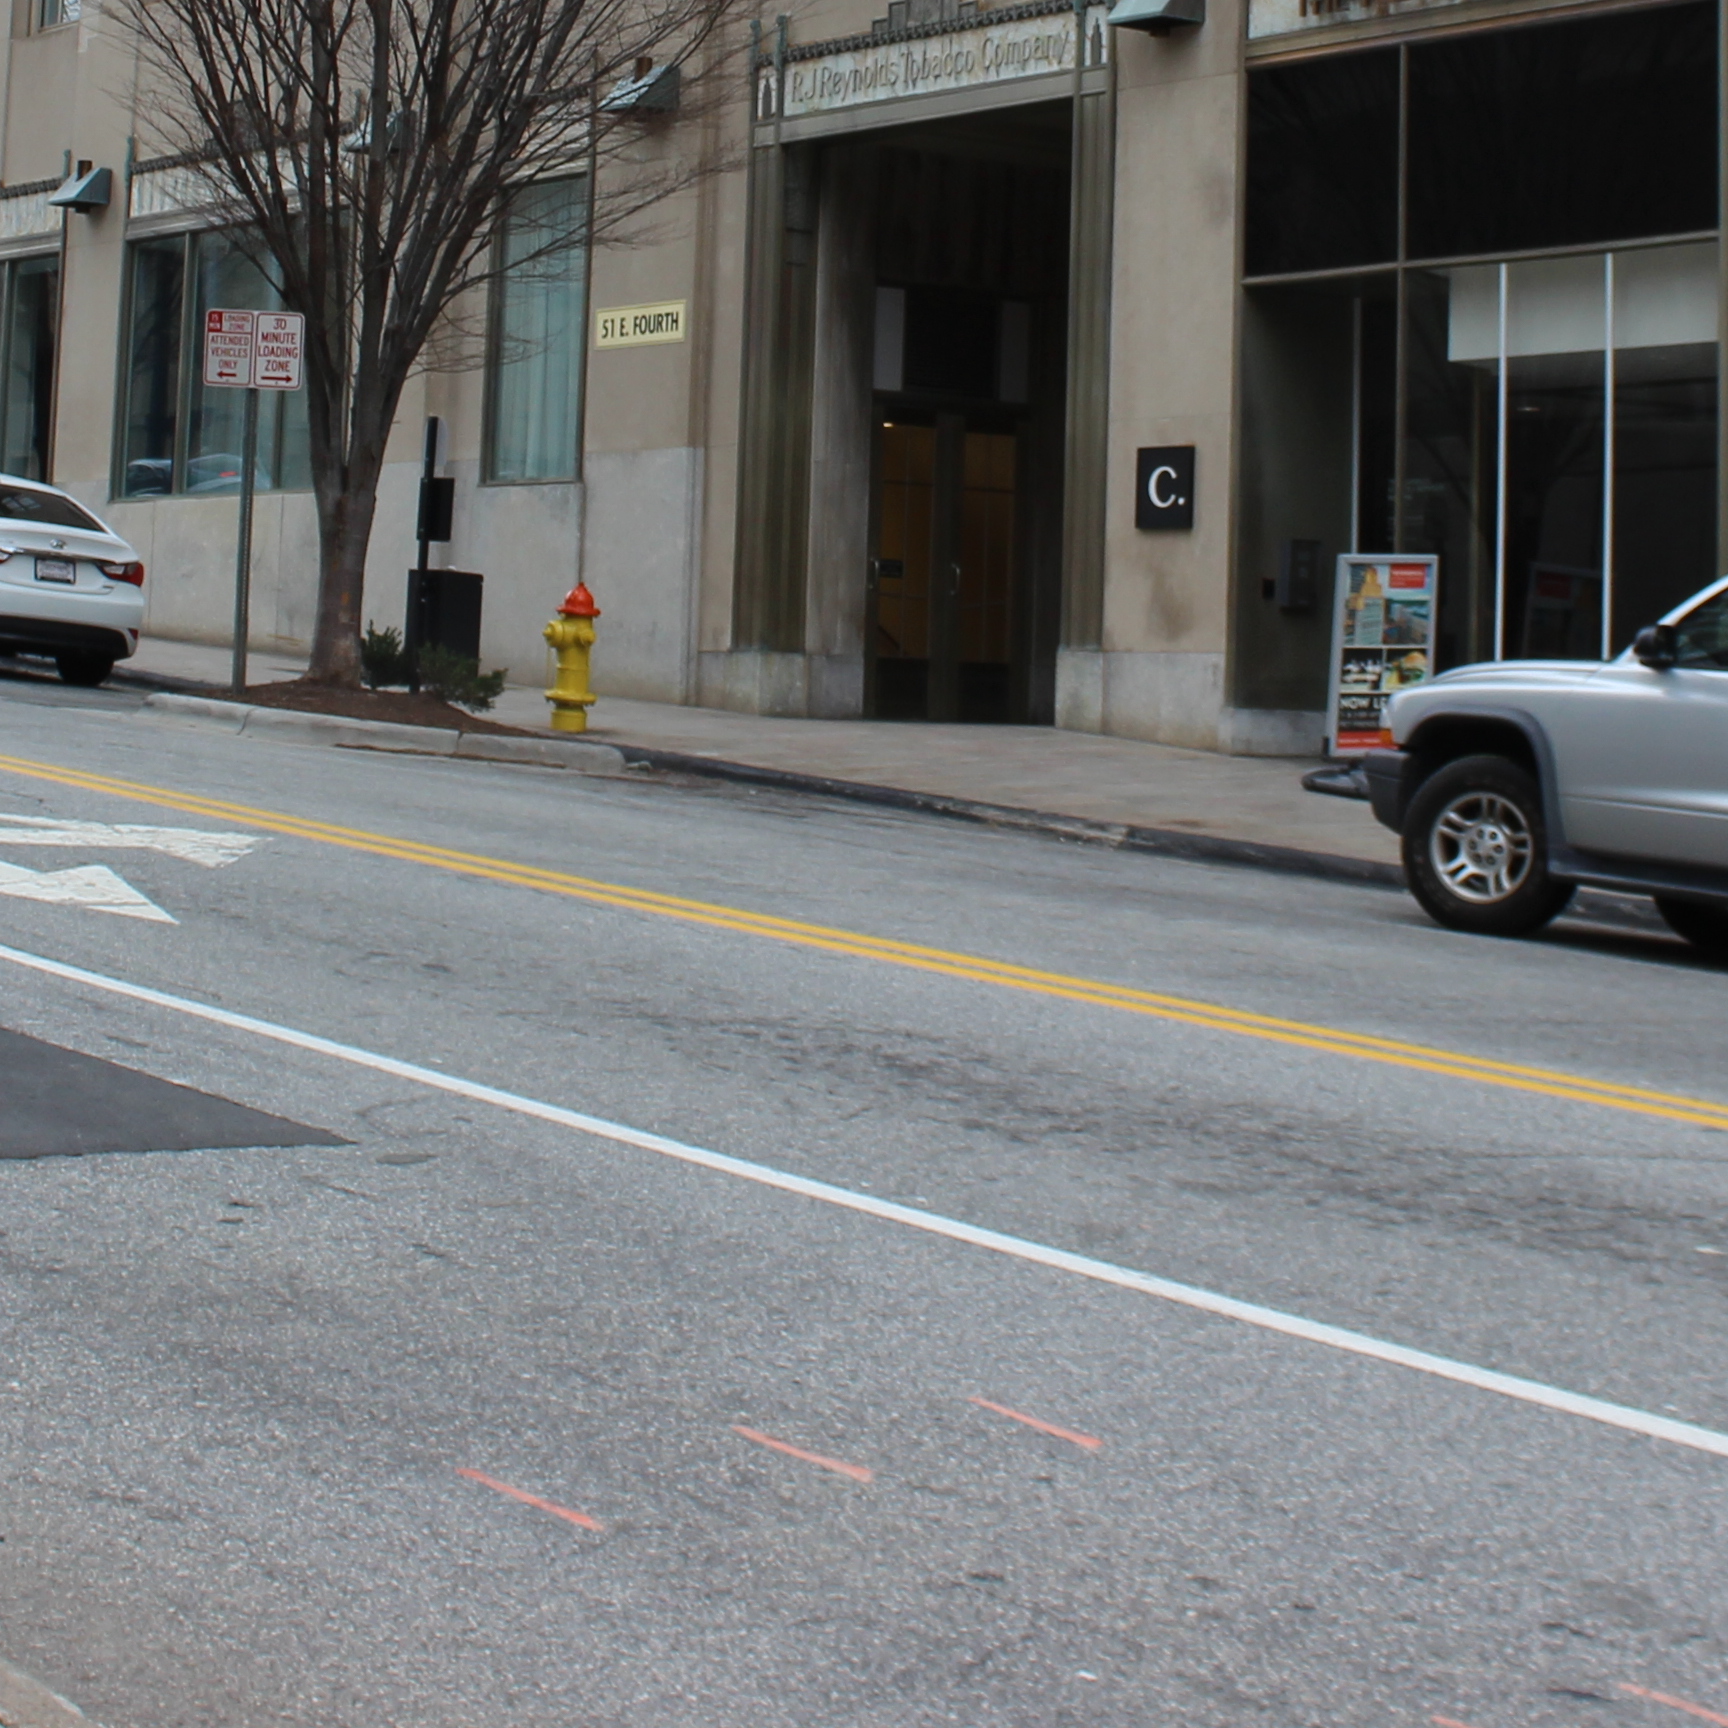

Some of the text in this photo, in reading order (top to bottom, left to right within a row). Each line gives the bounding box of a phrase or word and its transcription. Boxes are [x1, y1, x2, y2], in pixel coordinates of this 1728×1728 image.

[901, 43, 975, 84] Tobacco
[981, 31, 1069, 69] Company
[273, 318, 287, 330] 30
[601, 311, 679, 339] 51 E. FOURTH
[210, 335, 249, 346] ATTENDED
[262, 332, 296, 345] MINUTE
[211, 347, 248, 358] VEHICLES
[258, 345, 298, 359] LOADING
[218, 359, 237, 369] ONLY
[265, 359, 291, 372] ZONE
[1148, 465, 1186, 509] C.
